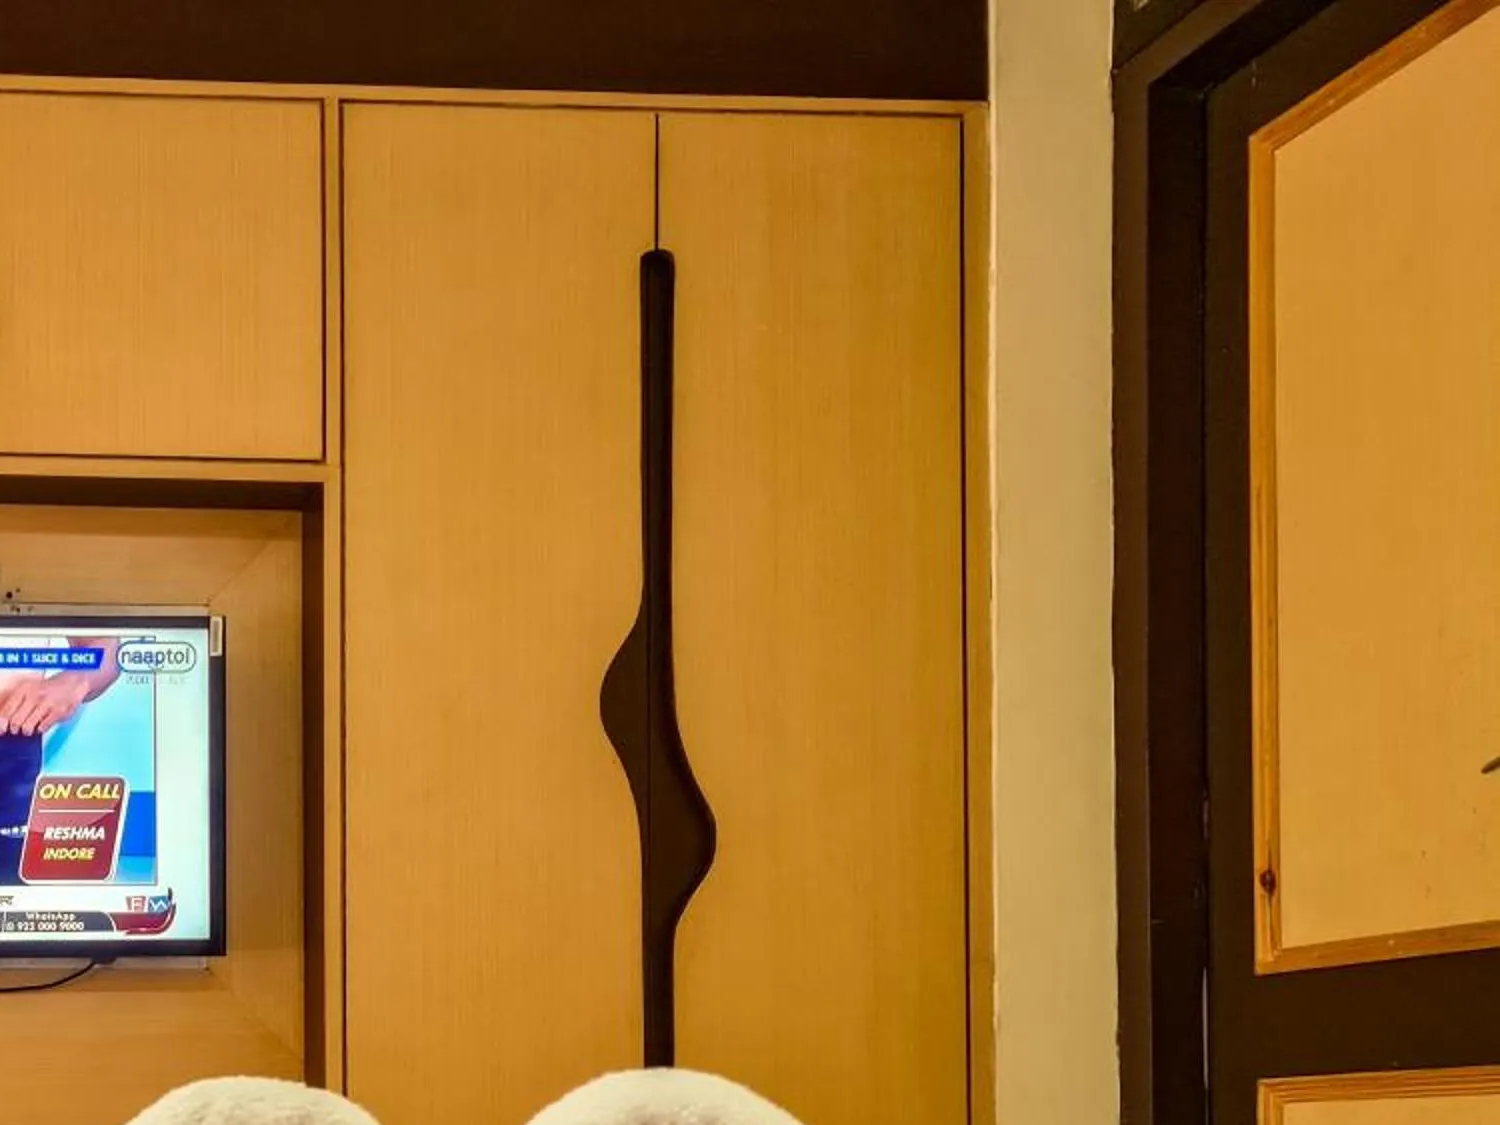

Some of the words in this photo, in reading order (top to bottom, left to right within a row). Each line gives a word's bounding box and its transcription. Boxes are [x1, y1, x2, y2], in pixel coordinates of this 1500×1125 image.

[121, 648, 191, 666] naaptol
[39, 783, 73, 800] ON
[75, 783, 121, 800] CALL
[43, 826, 106, 841] RESHMA
[43, 847, 97, 861] INDORE
